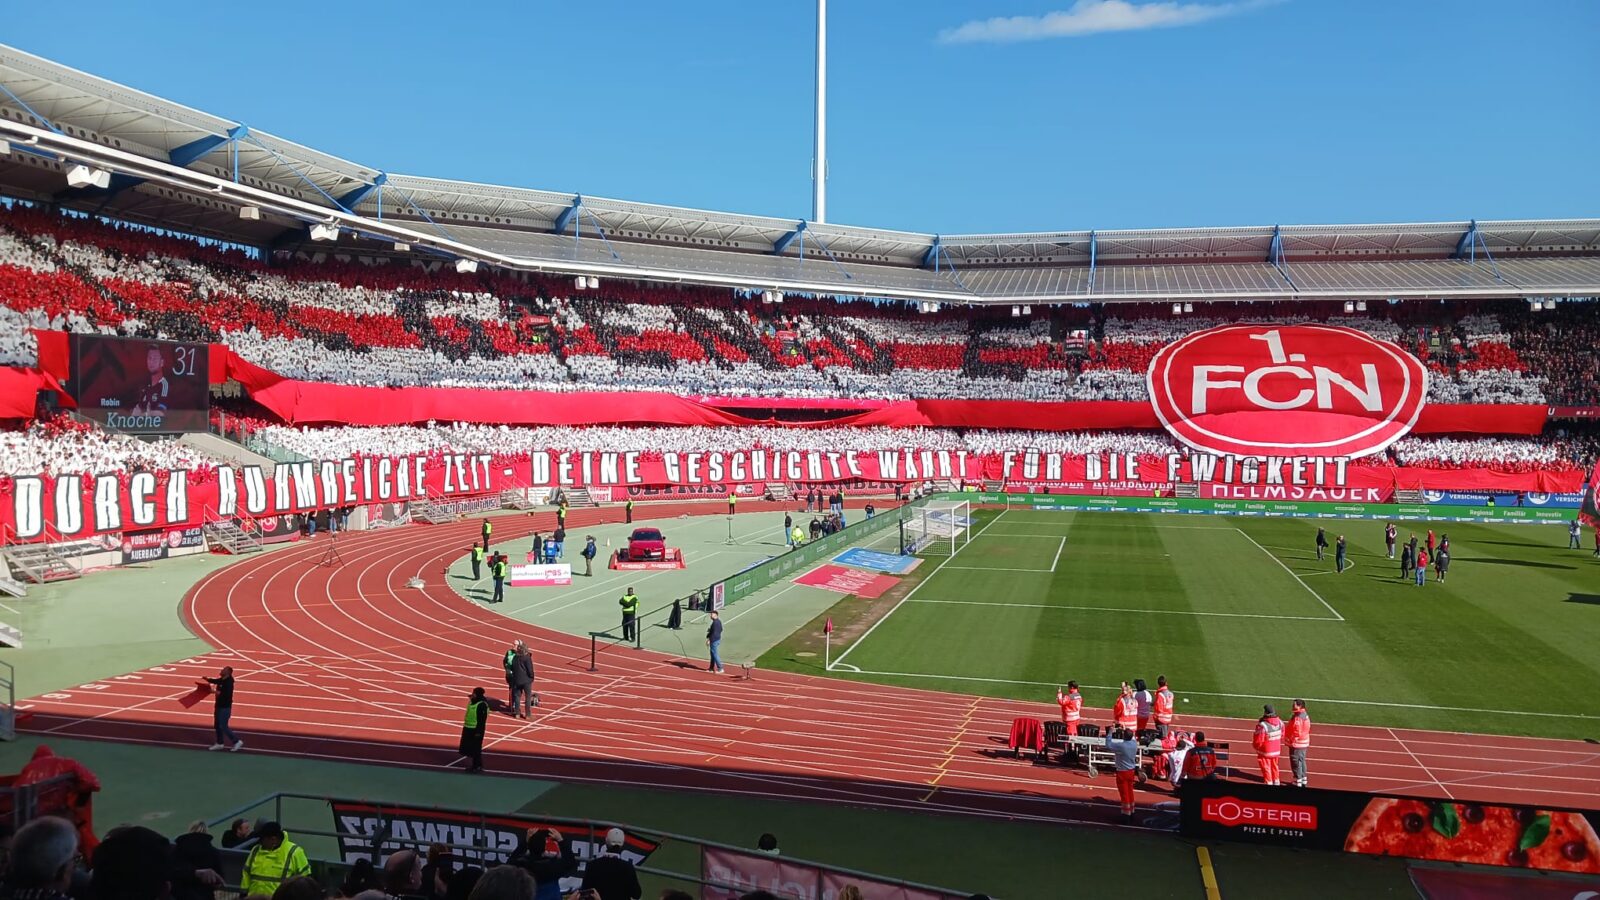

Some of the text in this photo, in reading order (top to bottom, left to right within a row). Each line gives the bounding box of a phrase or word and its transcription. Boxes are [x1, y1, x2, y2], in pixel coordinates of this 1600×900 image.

[1250, 330, 1306, 364] 1.
[172, 346, 196, 376] 31
[1191, 363, 1383, 415] FCN
[100, 398, 120, 407] Robin
[106, 412, 162, 428] Knoche
[14, 469, 189, 538] DURCH
[217, 455, 428, 517] RUHMREICHE
[443, 452, 492, 494] ZEIT
[531, 450, 643, 486] DEINE
[663, 449, 863, 483] GESCHICHTE
[877, 447, 967, 479] WÄHRT
[1003, 447, 1062, 480] FÜR
[1085, 451, 1140, 481] DIE
[1167, 452, 1350, 486] EWIGKEIT
[1469, 509, 1494, 517] Regional
[1207, 802, 1312, 824] L'OSTERIA
[1243, 826, 1267, 834] PIZZA
[1278, 829, 1304, 837] PASTA
